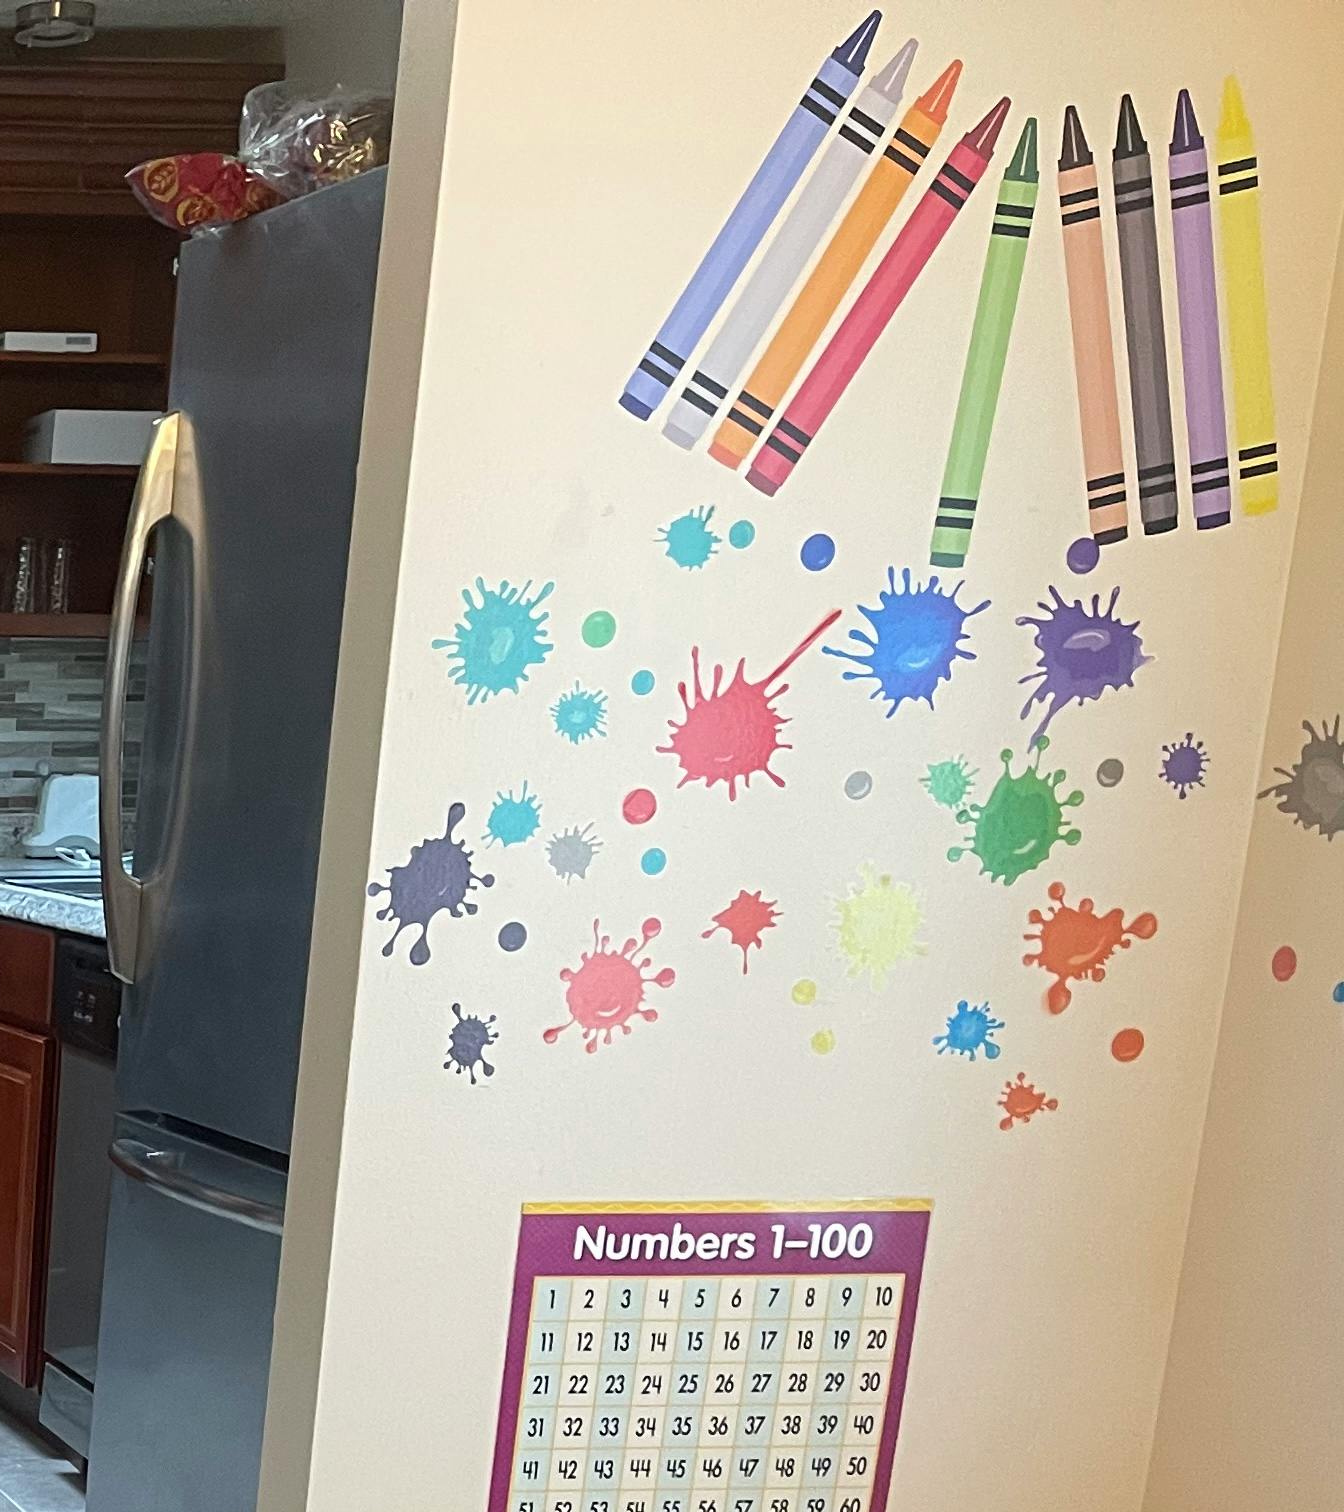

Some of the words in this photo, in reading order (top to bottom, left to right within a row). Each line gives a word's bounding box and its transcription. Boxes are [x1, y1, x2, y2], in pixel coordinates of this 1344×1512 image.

[573, 1223, 756, 1261] Numbers
[550, 1289, 556, 1309] 1
[583, 1289, 594, 1309] 2
[620, 1288, 632, 1309] 3
[658, 1289, 669, 1309] 4
[694, 1288, 706, 1308] 5
[731, 1288, 742, 1308] 6
[768, 1288, 780, 1308] 7
[805, 1287, 816, 1307] 8
[841, 1287, 853, 1307] 9
[876, 1286, 893, 1306] 10
[541, 1332, 554, 1352] 11
[577, 1332, 593, 1352] 12
[614, 1331, 630, 1352] 13
[650, 1332, 667, 1352] 14
[687, 1331, 704, 1351] 15
[724, 1331, 740, 1351] 16
[761, 1330, 778, 1350] 17
[797, 1330, 814, 1350] 18
[834, 1330, 851, 1350] 19
[866, 1329, 887, 1350] 20
[532, 1375, 550, 1395] 21
[567, 1374, 589, 1394] 22
[604, 1374, 625, 1394] 23
[641, 1375, 662, 1395] 24
[677, 1374, 699, 1394] 25
[714, 1373, 734, 1394] 26
[751, 1373, 772, 1393] 27
[788, 1373, 808, 1393] 28
[823, 1372, 845, 1392] 29
[859, 1372, 881, 1392] 30
